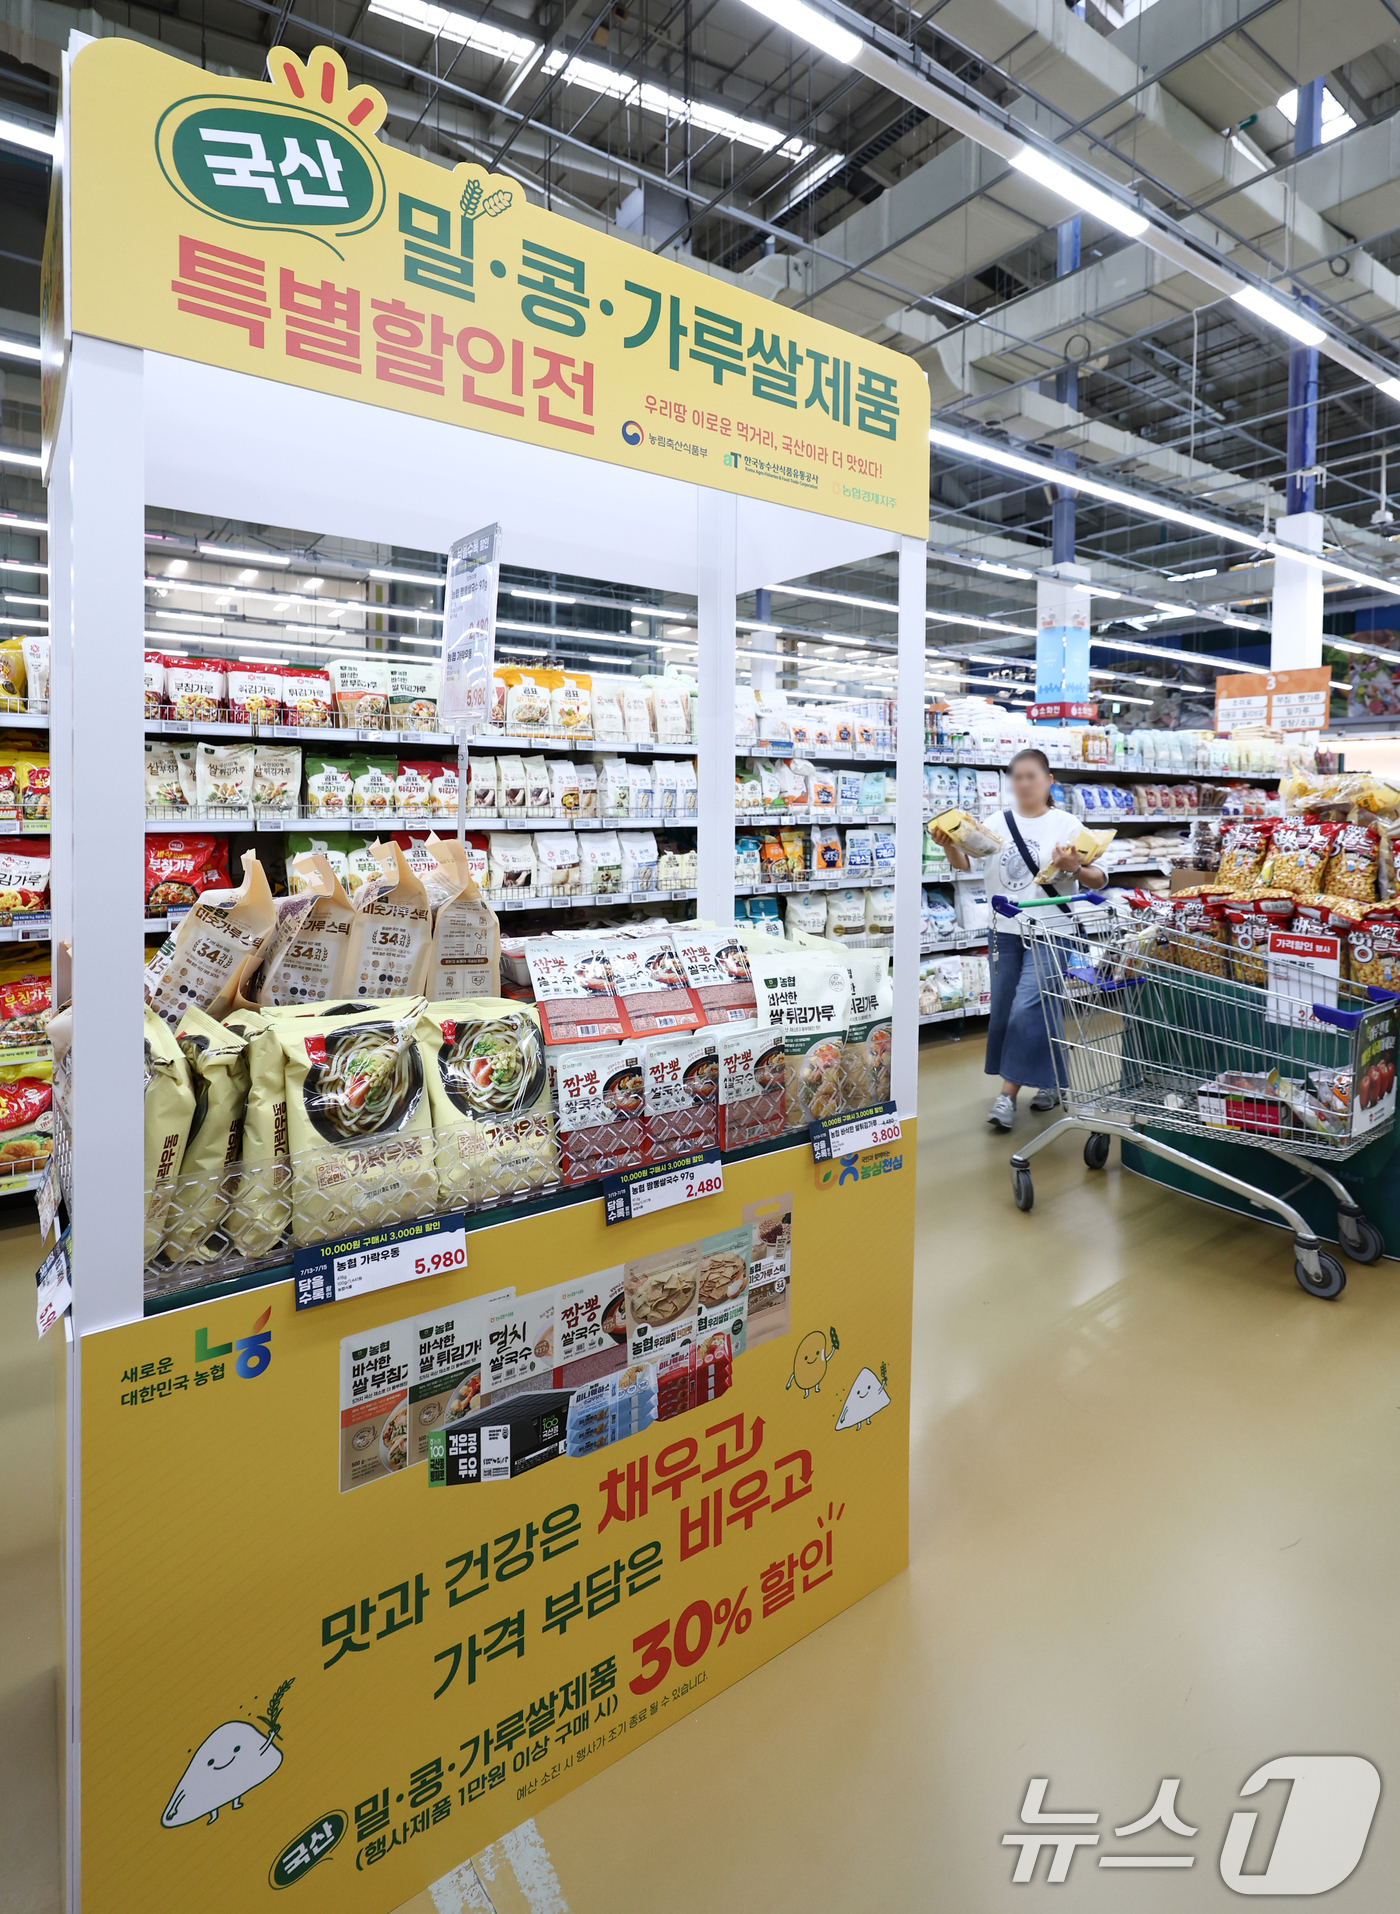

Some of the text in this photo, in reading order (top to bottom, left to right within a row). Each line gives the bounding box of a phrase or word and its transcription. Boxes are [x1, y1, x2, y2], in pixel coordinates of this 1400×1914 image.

[199, 127, 350, 209] 국산
[398, 180, 900, 442] 밀·콩·가루쌀제품
[171, 234, 595, 436] 특별할인전
[644, 394, 883, 479] 우리땅 이로운 먹거리, 국산이라 더 맛있다!
[648, 433, 709, 459] 농림축산식품부
[723, 451, 742, 469] aT
[744, 454, 820, 485] 한국농수산식품유통공사
[842, 484, 897, 509] 농협경제지주
[174, 682, 214, 695] 부침가루
[522, 686, 539, 696] 곰표
[1265, 675, 1277, 691] 3
[288, 688, 324, 698] 튀김가루
[466, 687, 486, 708] 5,980
[563, 689, 581, 698] 곰표
[1038, 705, 1061, 715] 소화전
[1286, 706, 1310, 715] 밀가루
[147, 761, 160, 776] 쌀
[208, 763, 220, 777] 쌀
[411, 850, 428, 858] 곰표
[149, 857, 195, 874] 부침가루
[195, 907, 242, 939] 미숫가루
[409, 909, 429, 922] 스틱
[326, 921, 350, 936] 스틱
[1369, 923, 1399, 941] 한입
[378, 931, 400, 946] 34
[398, 934, 407, 948] 가지
[1275, 938, 1331, 954] 가격할인 행사
[196, 942, 221, 964] 34
[217, 952, 229, 967] 가지
[290, 944, 314, 960] 34
[313, 947, 323, 961] 가지
[681, 945, 711, 963] 짬뽕
[532, 956, 568, 975] 짬뽕
[687, 963, 717, 976] 쌀국수
[779, 976, 796, 988] 농협
[767, 991, 798, 1007] 바삭한
[769, 1005, 835, 1026] 쌀 튀김가루
[649, 1057, 682, 1084] 짬뽕
[723, 1048, 754, 1075] 짬뽕
[562, 1069, 600, 1098] 짬뽕
[723, 1072, 754, 1090] 쌀국수
[650, 1083, 683, 1100] 쌀국수
[821, 1105, 884, 1128] 10,000원 구매시 3,000원 할인
[830, 1119, 878, 1139] 농협 바삭한 쌀튀김가루
[871, 1125, 900, 1143] 3,800
[813, 1139, 827, 1152] 담을
[814, 1149, 828, 1161] 수록
[620, 1154, 704, 1183] 10,000원 구매시 3,000원 할인
[860, 1154, 903, 1180] 농심천심
[631, 1171, 695, 1195] 농협 짬뽕쌀국수 97g
[685, 1176, 722, 1198] 2,480
[606, 1197, 625, 1211] 담을
[608, 1207, 625, 1222] 수록
[320, 1221, 441, 1257] 10,000원 구매시 3,000원 할인
[336, 1246, 400, 1272] 농협 가락우동
[414, 1248, 465, 1275] 5,980
[300, 1264, 328, 1276] 7/13-7/15
[773, 1263, 786, 1277] 스틱
[298, 1275, 325, 1293] 담을
[325, 1285, 333, 1299] 할인
[298, 1288, 325, 1305] 수록
[561, 1294, 602, 1329] 짬뽕
[434, 1320, 455, 1336] 농협
[561, 1322, 601, 1348] 쌀국수
[419, 1333, 456, 1356] 바삭한
[489, 1321, 527, 1355] 멸치
[631, 1336, 654, 1356] 농협
[368, 1340, 391, 1357] 농협
[352, 1354, 392, 1379] 바삭한
[419, 1355, 434, 1374] 쌀
[488, 1346, 533, 1373] 쌀국수
[121, 1356, 174, 1385] 새로운
[121, 1362, 226, 1407] 대한민국 농협
[352, 1376, 369, 1397] 쌀
[542, 1417, 559, 1431] 100
[542, 1425, 559, 1438] 국산콩
[430, 1445, 445, 1458] 100
[448, 1432, 477, 1457] 검은콩
[351, 1460, 361, 1468] 500
[458, 1456, 478, 1479] 두유
[321, 1413, 767, 1671] 맛과 건강은 채우고
[433, 1448, 814, 1700] 가격 부담은 비우고
[628, 1529, 835, 1697] 30% 할인
[516, 1670, 709, 1801] 예산 소진 시 행사가 조기 종료 될 수 있습니다.
[354, 1655, 619, 1844] 밀·콩·가루쌀제품
[355, 1692, 619, 1872] (행사제품 1만원 이상 구매 시)
[282, 1820, 336, 1876] 국산
